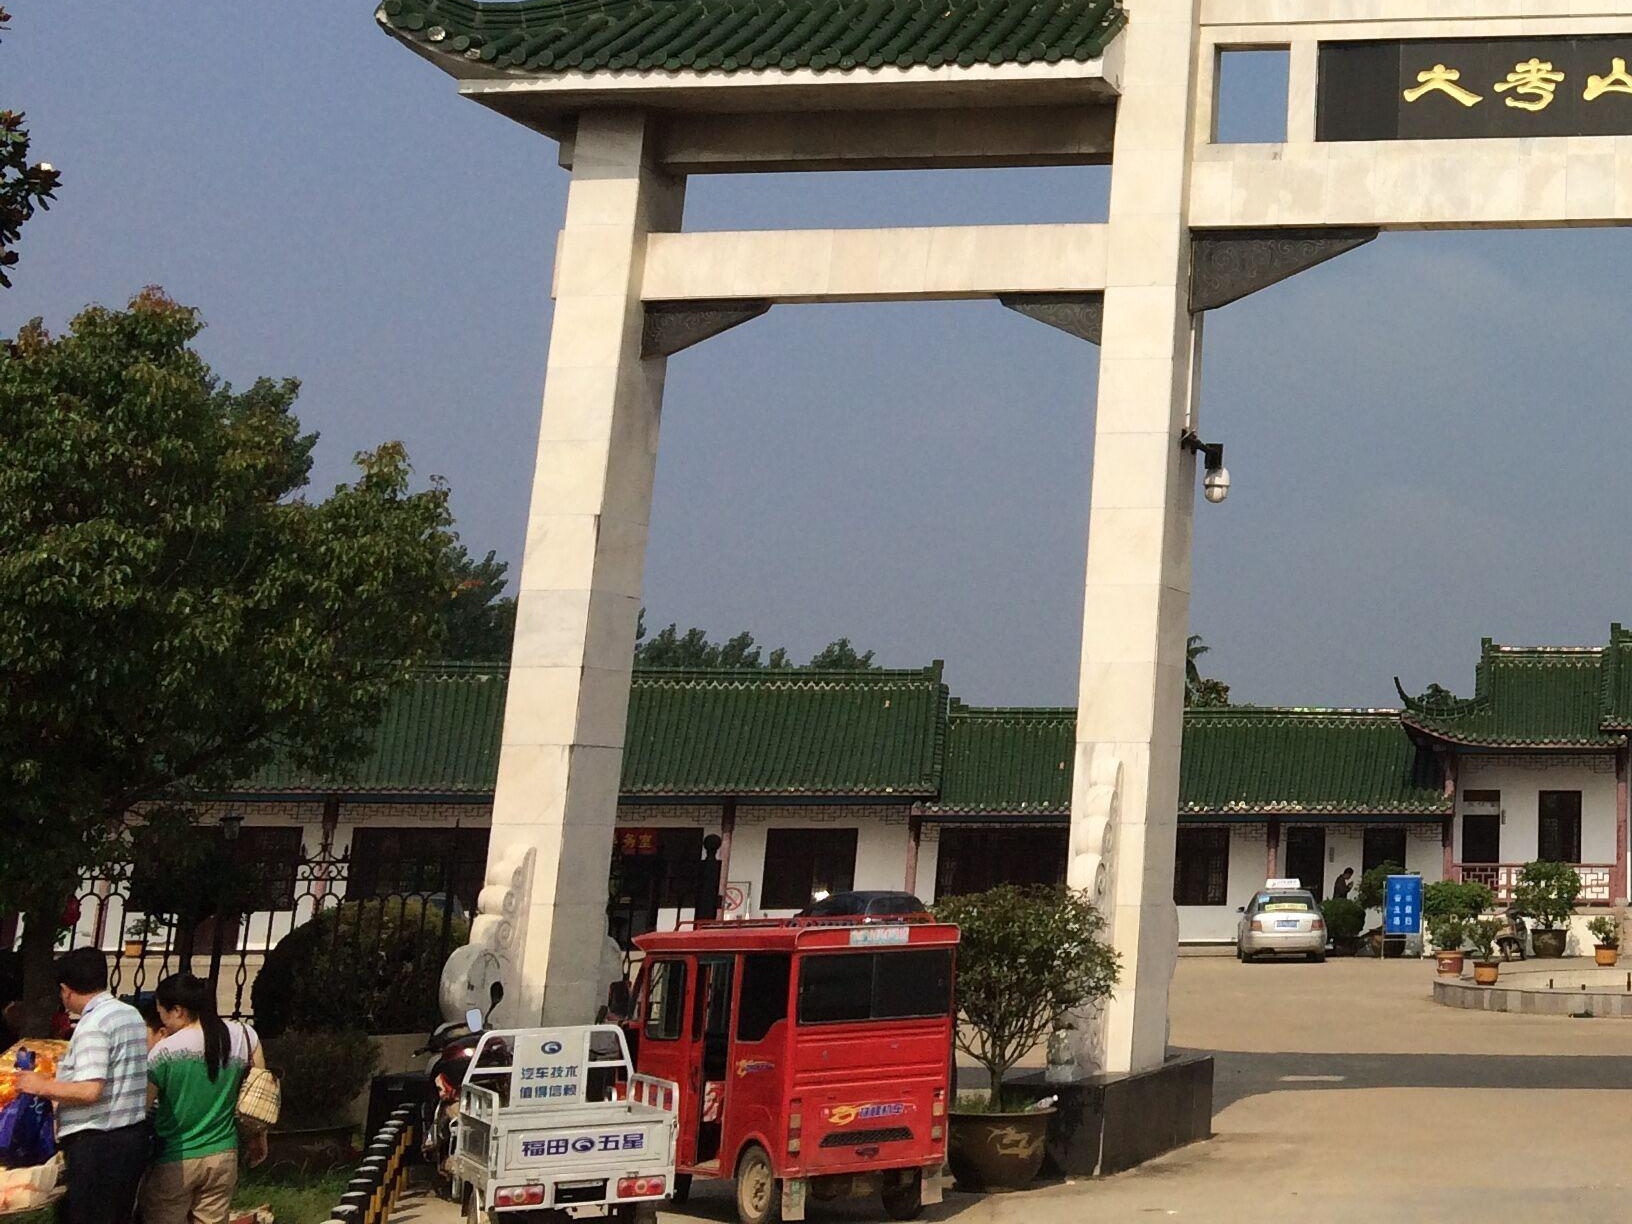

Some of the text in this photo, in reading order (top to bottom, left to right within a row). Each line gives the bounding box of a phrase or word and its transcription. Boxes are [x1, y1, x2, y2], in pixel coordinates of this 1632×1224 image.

[520, 1065, 579, 1080] 汽车技术
[519, 1083, 577, 1099] 值得信赖
[521, 1133, 645, 1157] 福田 五星
